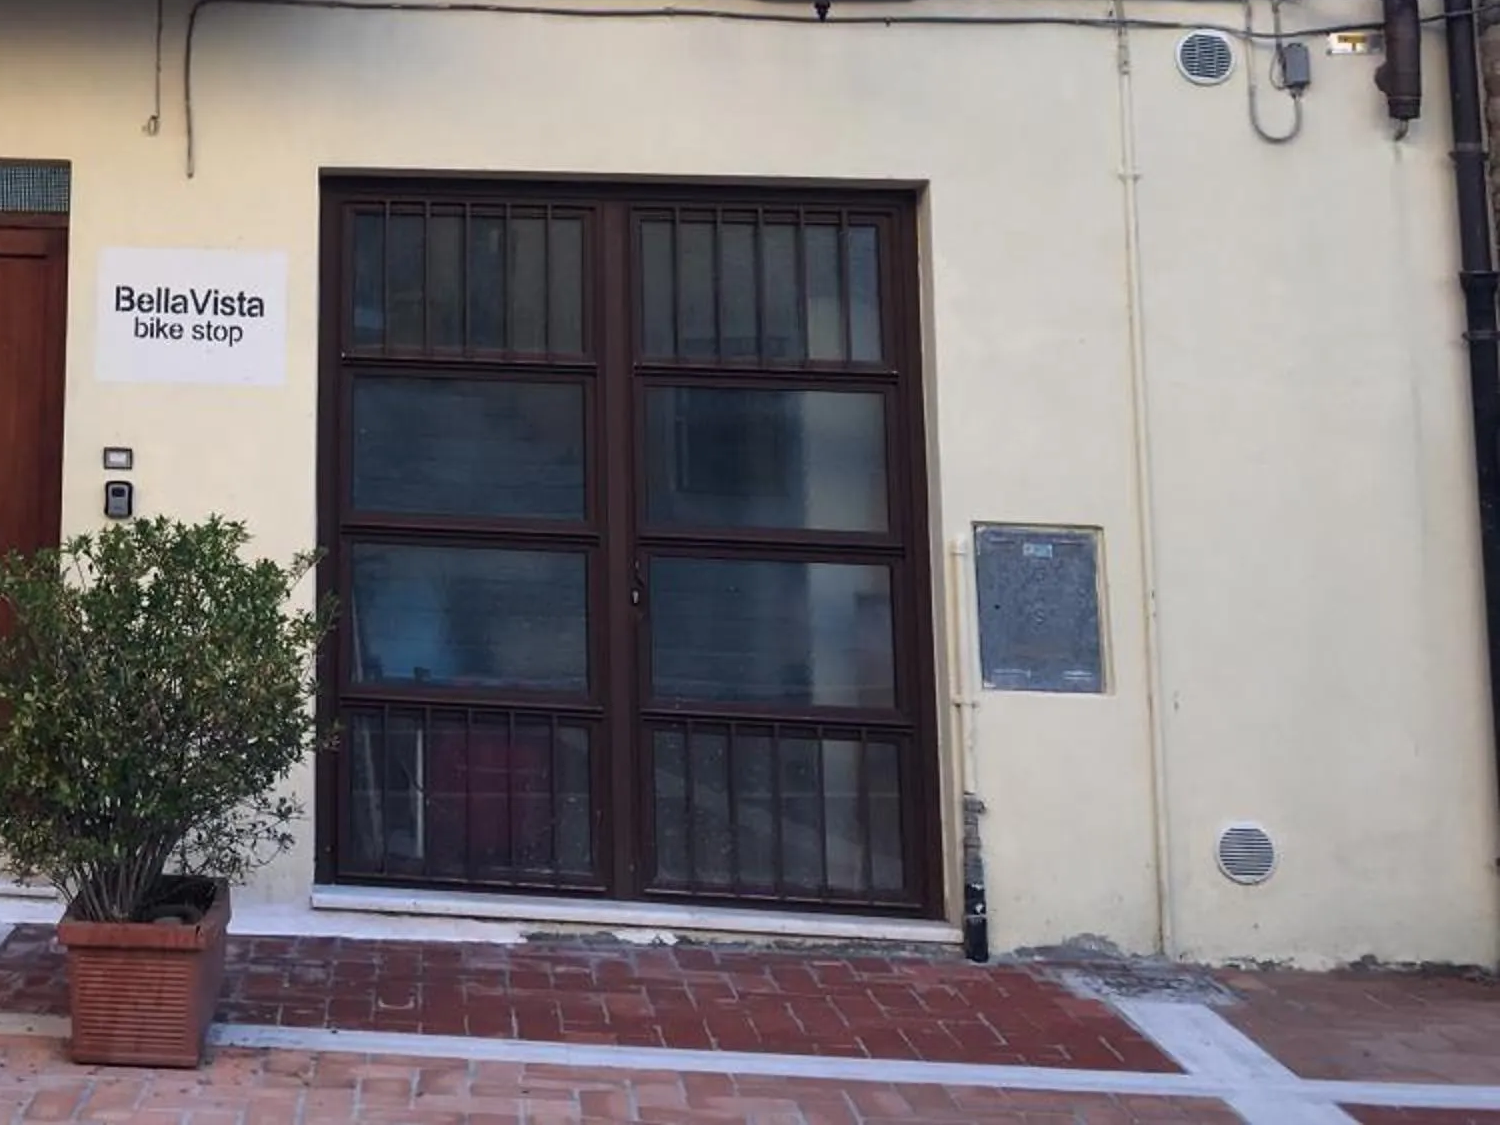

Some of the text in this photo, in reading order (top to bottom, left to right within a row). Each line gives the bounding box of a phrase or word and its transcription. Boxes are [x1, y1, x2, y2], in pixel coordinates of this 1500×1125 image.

[115, 286, 265, 317] BellaVista
[134, 317, 243, 347] bike stop
